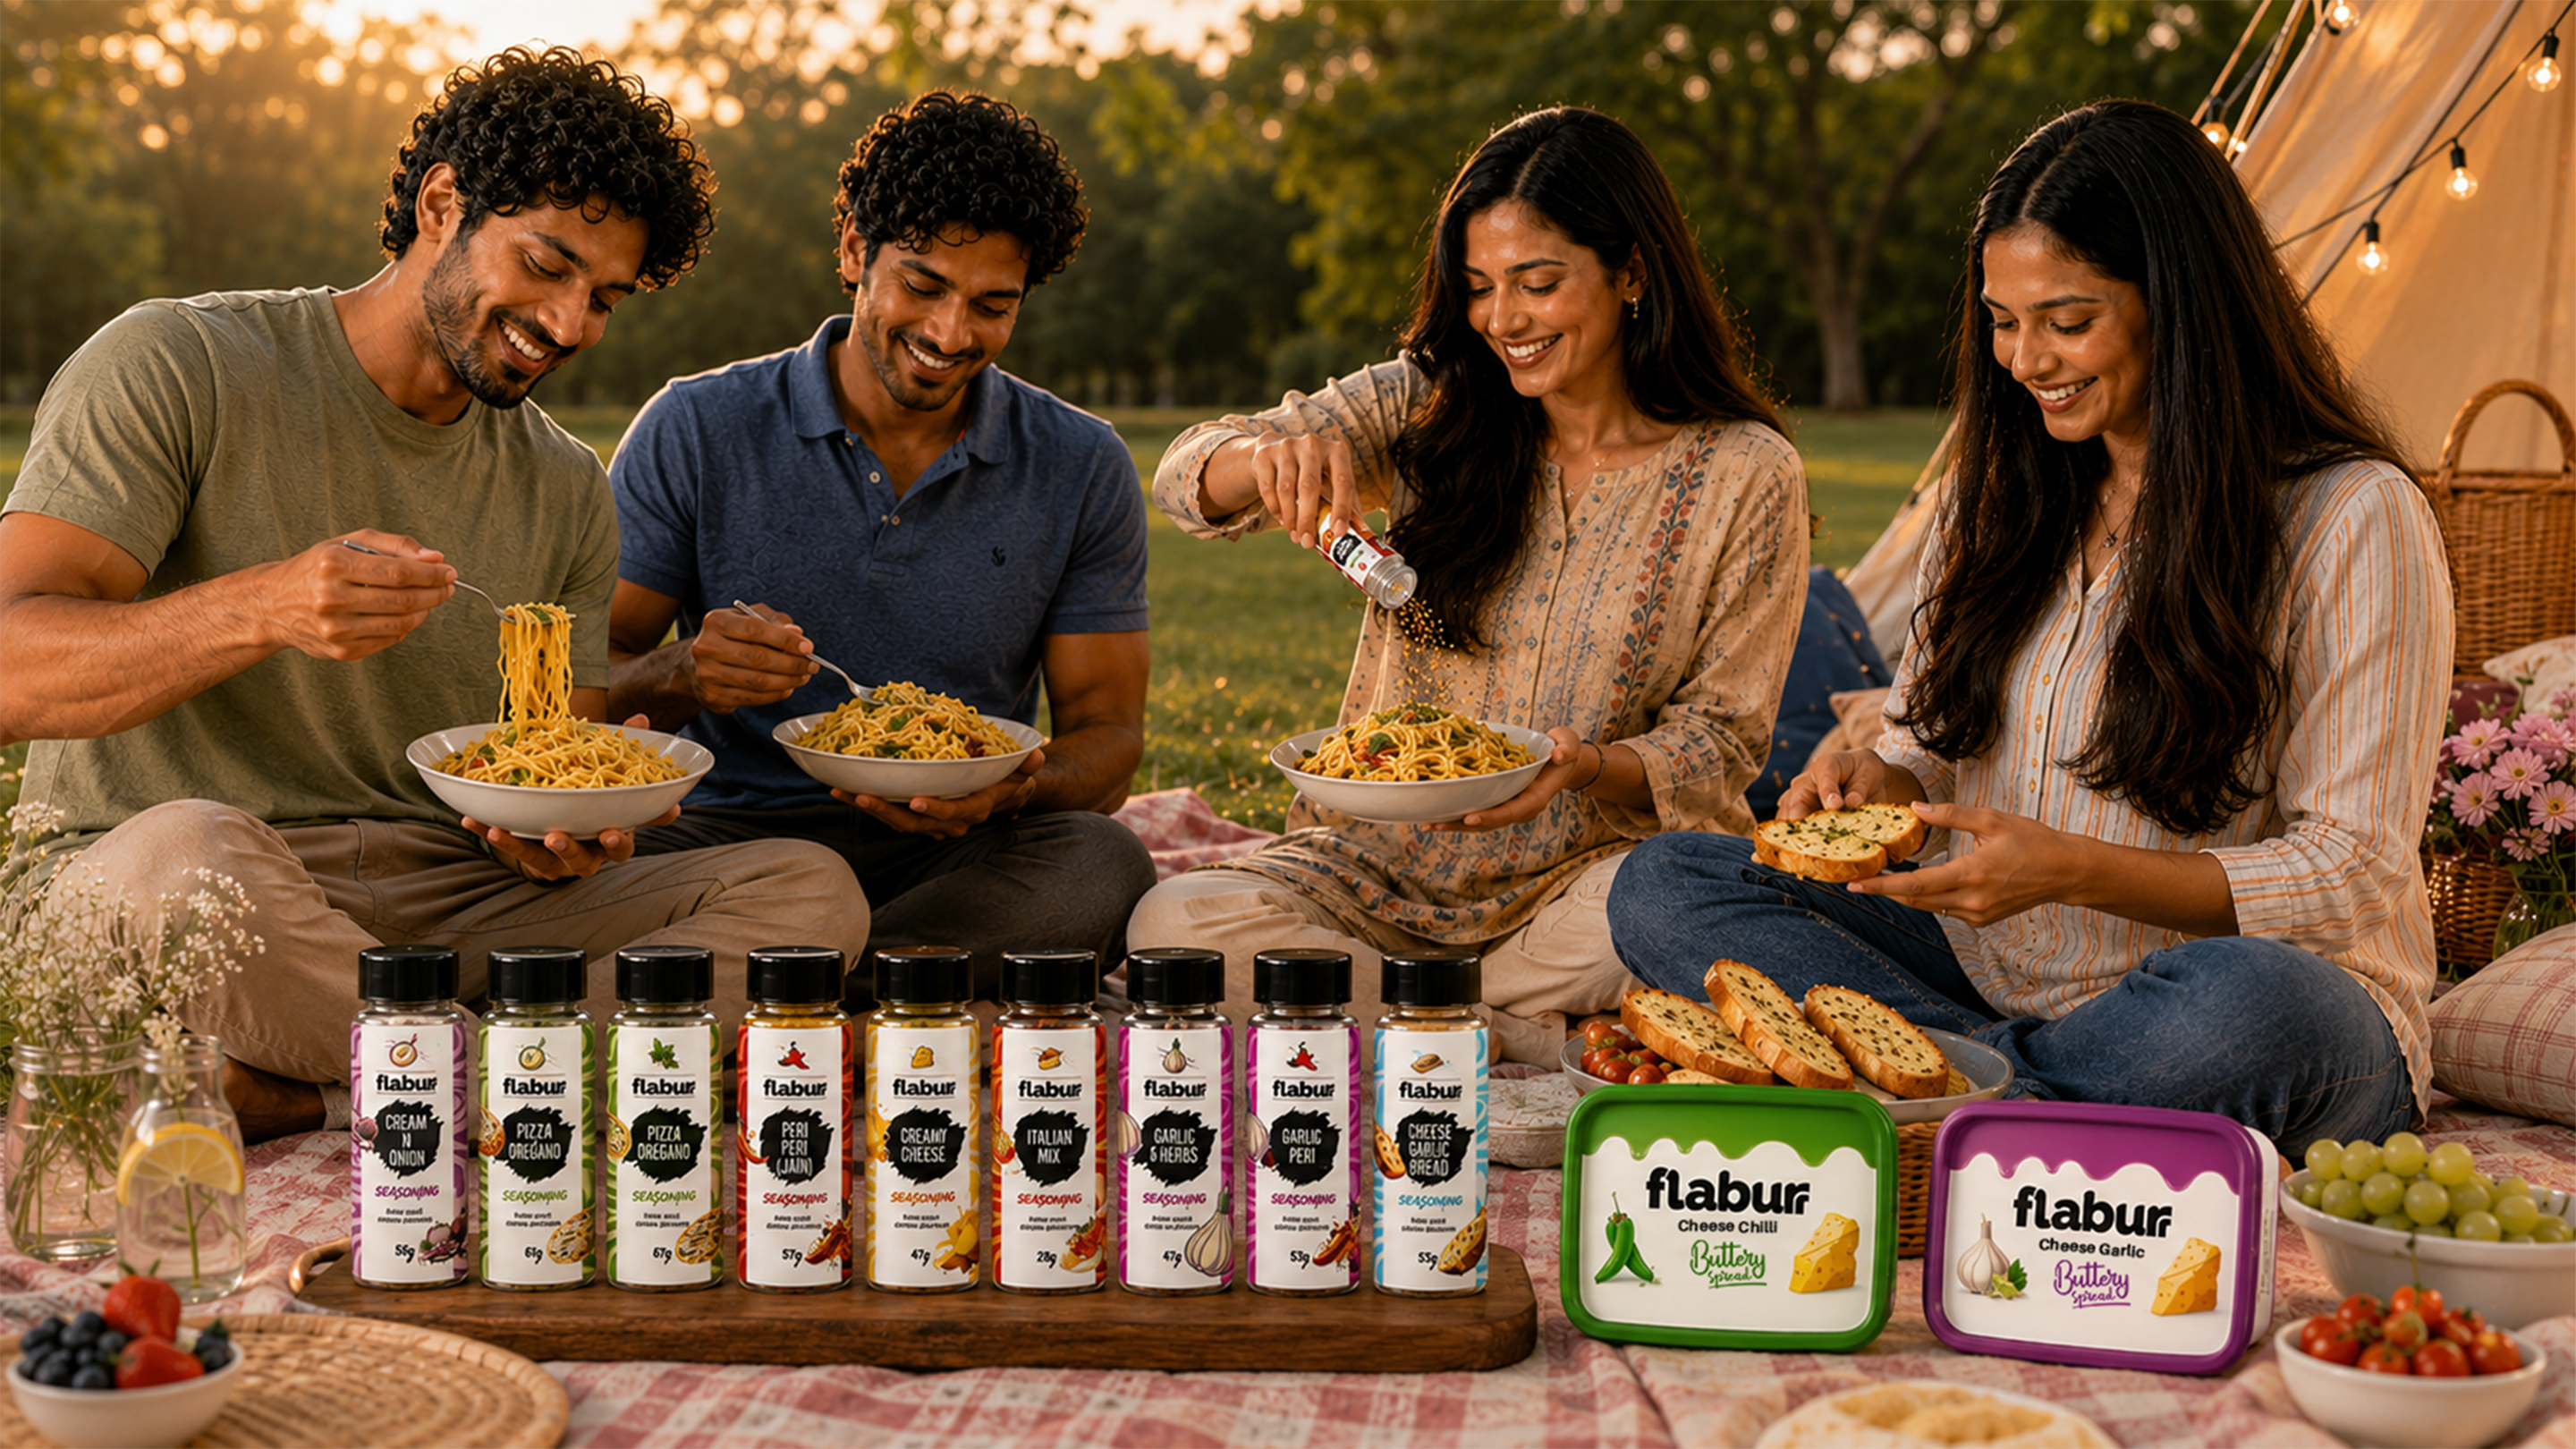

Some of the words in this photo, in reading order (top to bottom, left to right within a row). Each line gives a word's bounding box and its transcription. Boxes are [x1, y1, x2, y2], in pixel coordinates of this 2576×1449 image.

[386, 1114, 427, 1131] CREAM
[781, 1122, 808, 1138] PERI
[402, 1132, 411, 1148] N
[516, 1123, 553, 1140] PIZZA
[647, 1125, 681, 1141] PIZZA
[900, 1127, 947, 1144] CREAMY
[1027, 1129, 1072, 1145] ITALIAN
[1154, 1128, 1196, 1144] GARLIC
[1282, 1128, 1322, 1145] GARLIC
[1408, 1123, 1452, 1140] CHEESE
[508, 1142, 561, 1160] OREGANO
[637, 1143, 691, 1160] OREGANO
[781, 1140, 808, 1156] PERI
[901, 1146, 945, 1163] CHEESE
[1037, 1148, 1061, 1164] MIX
[1159, 1147, 1199, 1163] HERBS
[1289, 1147, 1316, 1164] PERI
[1408, 1141, 1450, 1158] GARLIC
[389, 1150, 425, 1166] ONION
[775, 1157, 813, 1176] (JAIN)
[1409, 1159, 1449, 1176] BREAD
[375, 1185, 439, 1200] SEASONING
[631, 1190, 696, 1206] SEASONING
[1678, 1218, 1734, 1233] Cheese
[1738, 1220, 1778, 1233] Chilli
[2038, 1237, 2096, 1254] Cheese
[2098, 1242, 2146, 1258] Garlic
[782, 1249, 802, 1267] 57g
[911, 1249, 931, 1267] 47g
[1162, 1250, 1182, 1268] 47g
[1690, 1239, 1766, 1279] Buttery
[2054, 1259, 2129, 1300] Buttery
